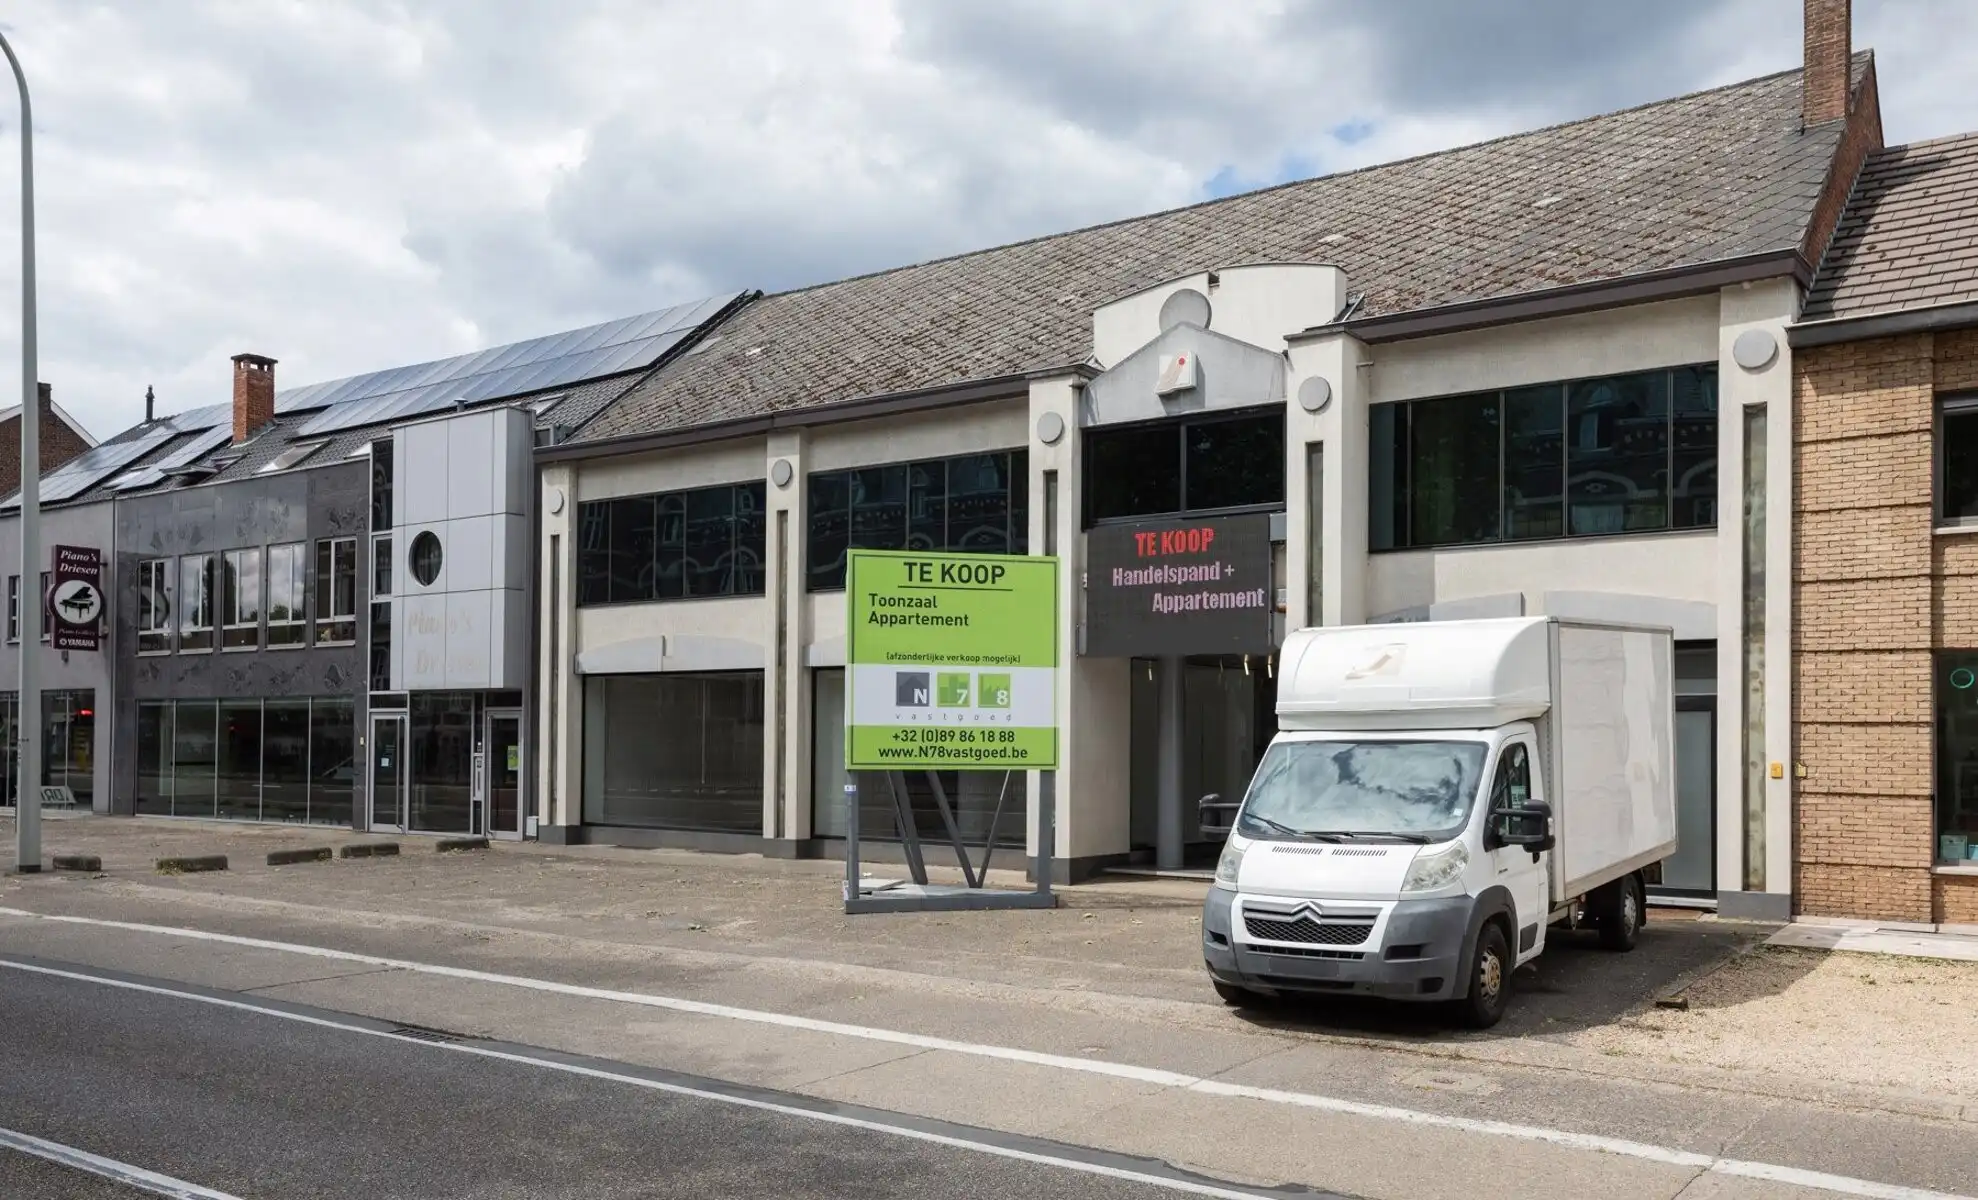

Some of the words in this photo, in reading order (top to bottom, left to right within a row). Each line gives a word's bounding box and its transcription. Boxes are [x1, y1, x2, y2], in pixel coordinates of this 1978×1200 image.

[1134, 531, 1157, 557] TE
[1161, 527, 1216, 555] KOOP
[60, 550, 97, 562] Piano's
[59, 562, 98, 575] Driesen
[903, 561, 933, 582] TE
[941, 563, 1006, 585] KOOP
[1112, 561, 1221, 587] Handelspand
[868, 593, 938, 609] Toonzaal
[1152, 587, 1265, 614] Appartement
[868, 611, 969, 628] Appartement
[946, 654, 981, 664] verkoop
[892, 729, 917, 742] +32
[921, 728, 956, 743] (0)89
[959, 730, 976, 743] 86
[980, 730, 996, 743] 18
[999, 730, 1015, 743] 88
[878, 745, 1029, 761] www.N78vastgoed.be
